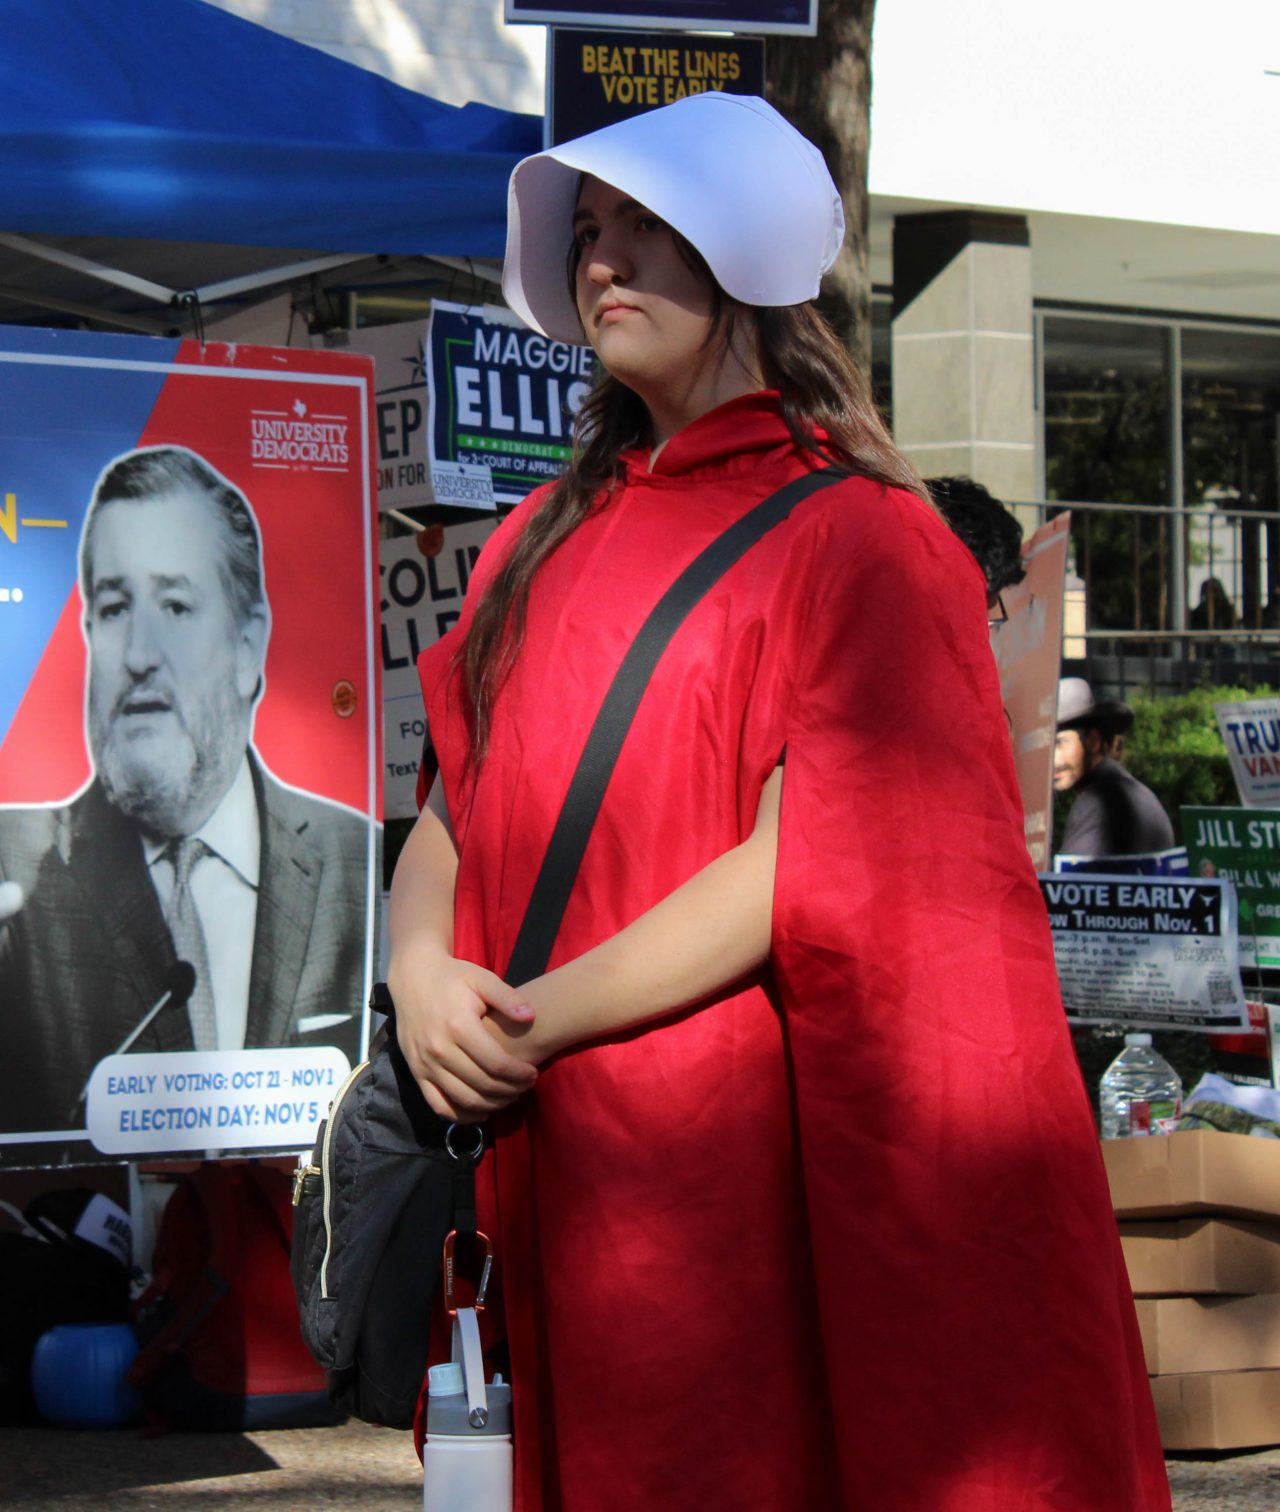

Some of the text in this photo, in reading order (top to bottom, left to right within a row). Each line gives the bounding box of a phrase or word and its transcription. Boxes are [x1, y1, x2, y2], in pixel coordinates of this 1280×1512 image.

[582, 45, 740, 80] BEAT THE LINES
[601, 76, 658, 105] VOTE
[474, 328, 592, 376] MAGGIE
[251, 419, 348, 444] UNIVERSITY
[376, 399, 421, 460] EP
[251, 440, 349, 464] DEMOCRATS
[457, 452, 471, 465] for
[483, 454, 513, 469] COURT
[513, 457, 527, 470] OF
[501, 441, 553, 456] DEMOCRAT
[399, 464, 426, 486] FOR
[433, 474, 493, 492] UNIVERSITY
[434, 485, 495, 503] DEMOCRATS
[380, 545, 481, 613] OLI
[400, 718, 430, 739] FO
[1227, 719, 1280, 755] TRU
[386, 760, 417, 779] Text
[1196, 819, 1242, 848] JILL
[1046, 883, 1196, 908] VOTE EARLY
[1049, 914, 1068, 927] OW
[1205, 915, 1215, 933] 1
[107, 1074, 157, 1095] EARLY
[164, 1071, 228, 1094] VOTING:
[232, 1070, 263, 1090] OCT
[267, 1070, 280, 1088] 21
[291, 1069, 324, 1087] NOV
[327, 1068, 333, 1085] 1
[120, 1102, 318, 1133] ELECTION DAY: NOV 5
